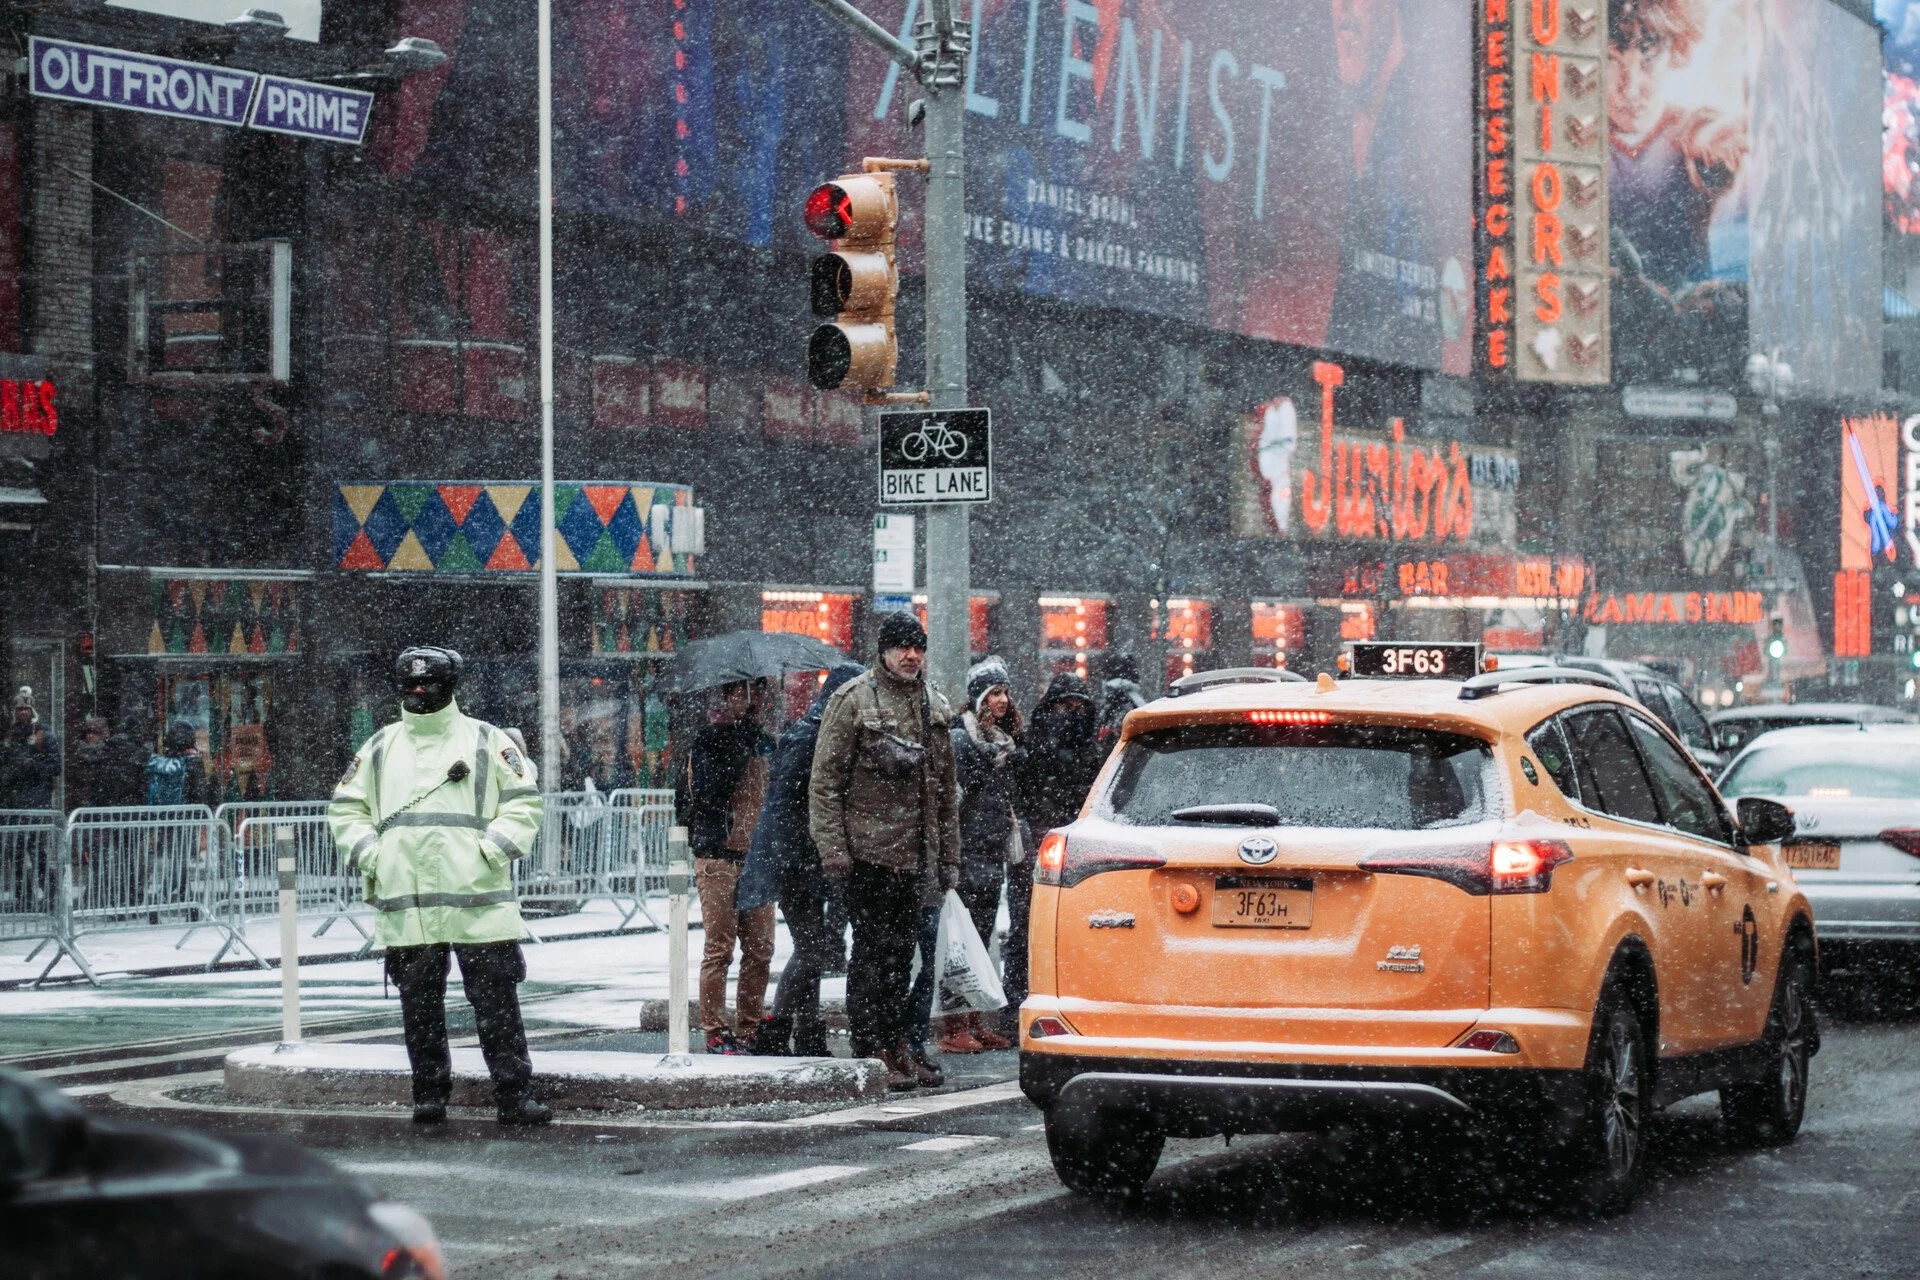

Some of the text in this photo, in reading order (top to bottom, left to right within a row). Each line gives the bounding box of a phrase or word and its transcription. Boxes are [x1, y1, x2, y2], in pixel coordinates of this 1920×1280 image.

[42, 48, 360, 134] OUTFRONT PRIME
[964, 213, 994, 244] UKE
[886, 471, 984, 495] BIKE LANE
[1382, 648, 1445, 673] 3F63
[1240, 880, 1289, 888] NEW YORK
[1236, 892, 1287, 916] 3F63H
[1088, 912, 1136, 929] RAV4
